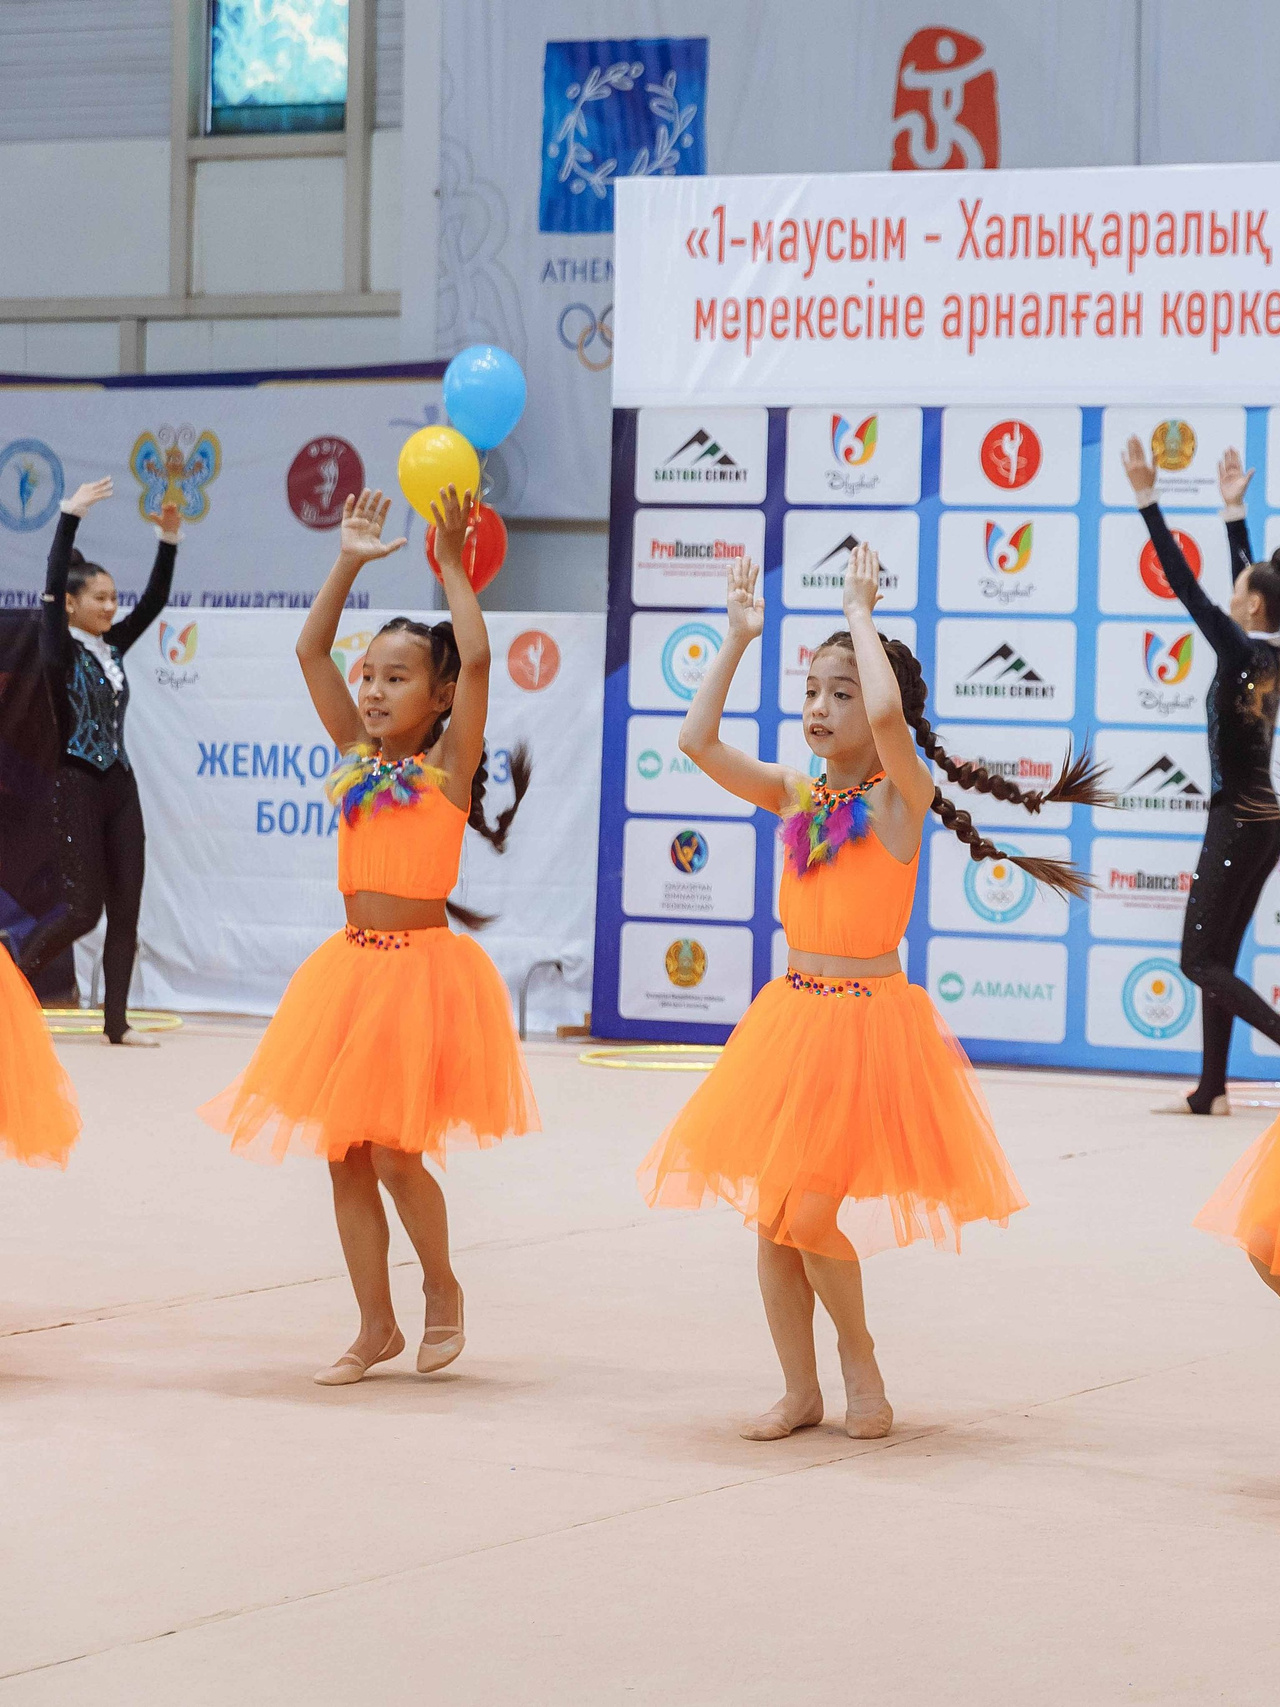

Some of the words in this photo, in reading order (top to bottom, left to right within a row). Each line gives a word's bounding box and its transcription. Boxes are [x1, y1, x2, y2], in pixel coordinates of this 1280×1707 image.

[685, 203, 907, 280] «1-маусым
[955, 197, 1272, 275] Халықаралық
[541, 257, 615, 283] ATHEN
[694, 279, 925, 357] мерекесіне
[941, 289, 1142, 356] арналған
[802, 574, 845, 588] SASTOB
[950, 756, 1053, 779] PDanceShop
[1169, 798, 1209, 812] CEMEN
[1110, 868, 1193, 892] ProDanceS
[971, 981, 1056, 1001] AMANAT
